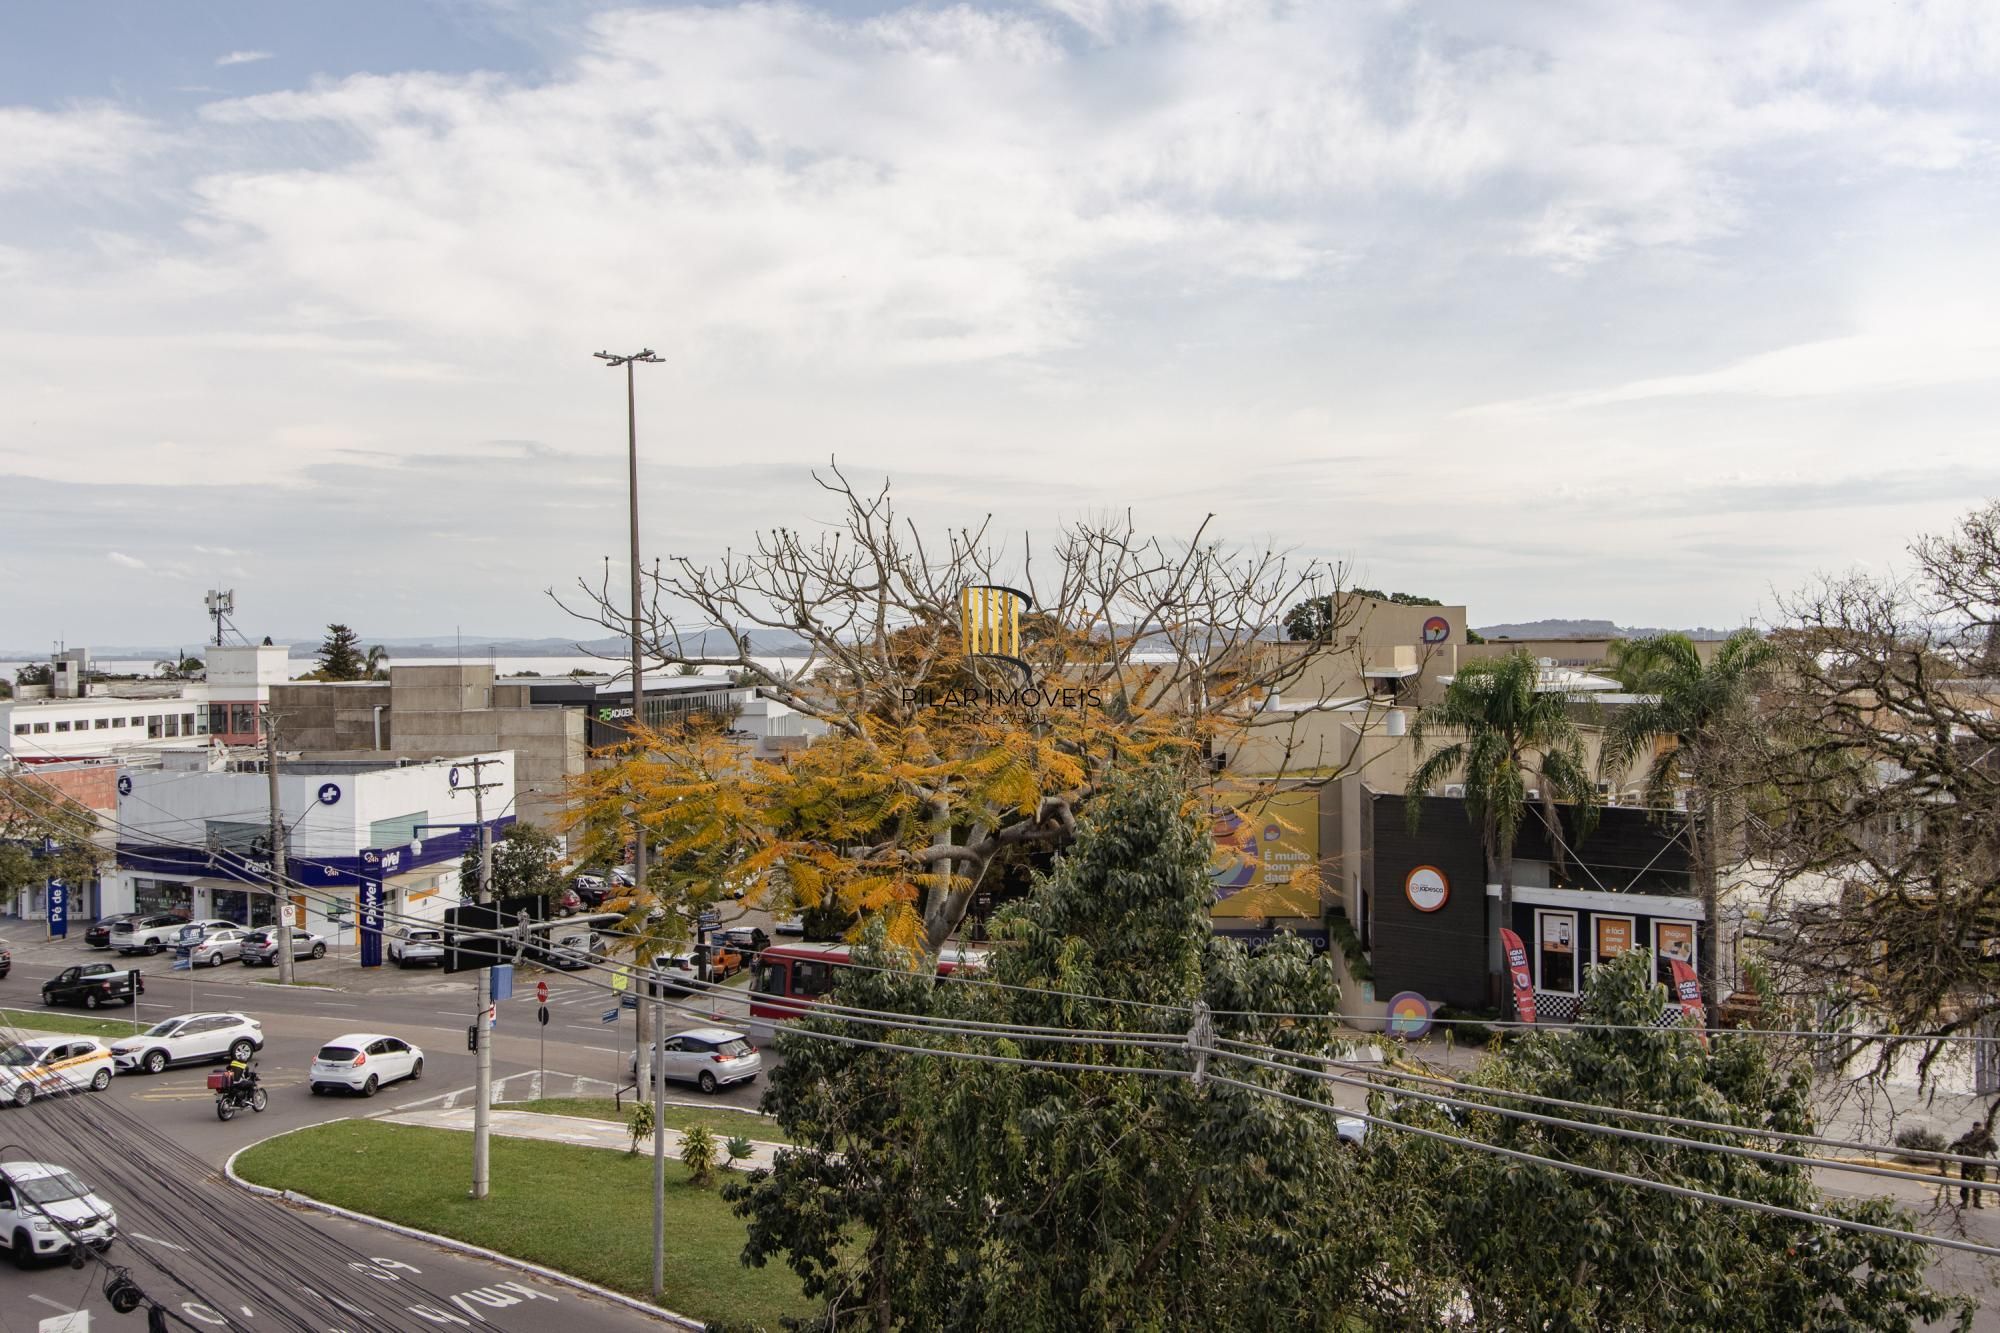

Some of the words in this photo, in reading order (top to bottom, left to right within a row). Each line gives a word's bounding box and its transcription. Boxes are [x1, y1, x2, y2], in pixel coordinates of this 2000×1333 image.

[1263, 848, 1272, 861] É
[1275, 851, 1311, 861] muito
[51, 889, 62, 904] de
[1680, 981, 1696, 989] AQUI
